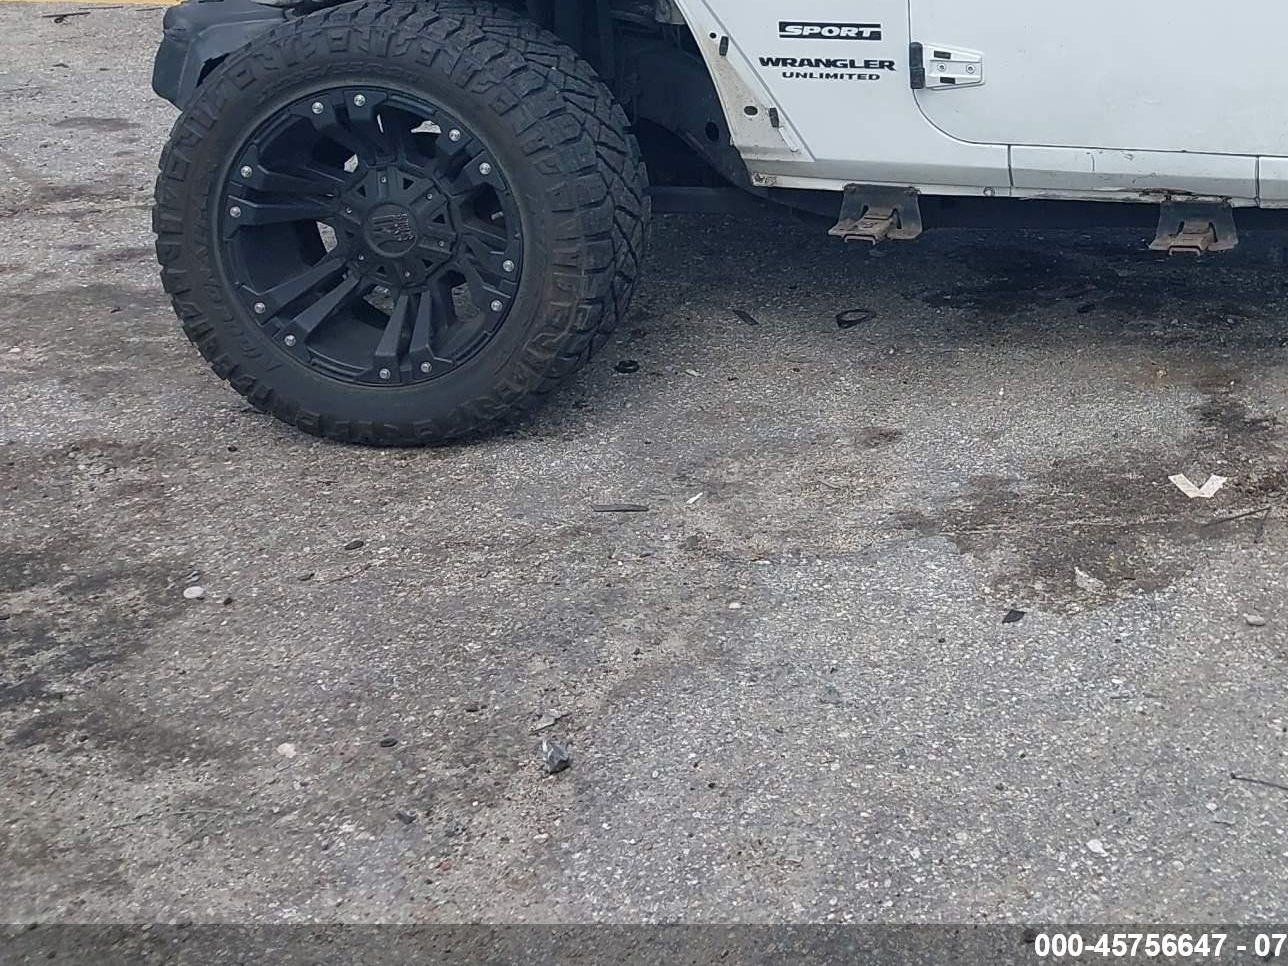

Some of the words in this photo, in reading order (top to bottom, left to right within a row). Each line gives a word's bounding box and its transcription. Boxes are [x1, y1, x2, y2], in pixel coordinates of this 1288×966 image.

[780, 25, 881, 38] SPORT
[759, 57, 896, 71] WRANGLER
[782, 71, 880, 81] UNLIMITED
